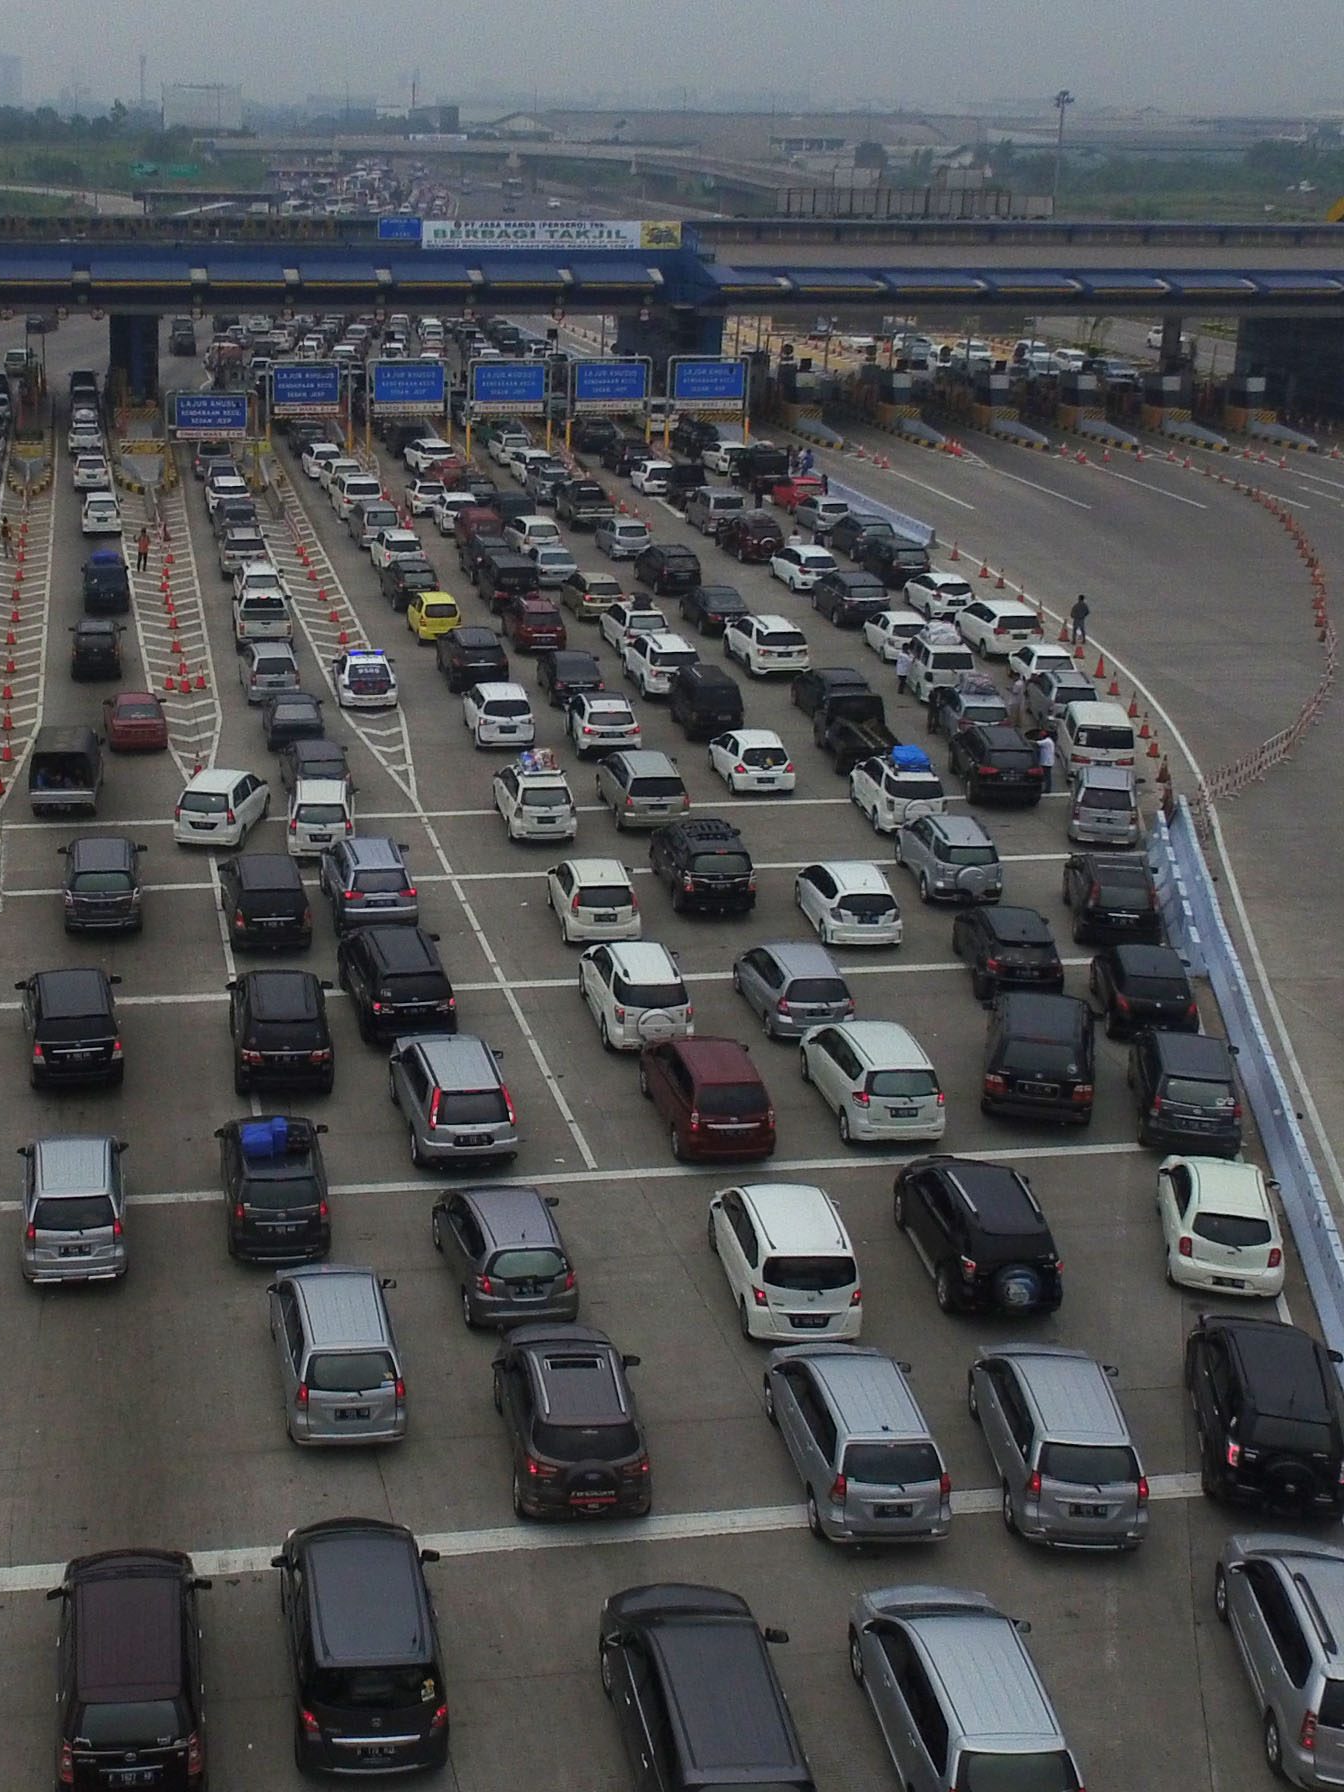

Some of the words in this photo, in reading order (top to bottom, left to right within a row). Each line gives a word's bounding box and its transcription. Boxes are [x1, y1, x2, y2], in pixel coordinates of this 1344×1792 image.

[433, 229, 536, 239] BERBAGI
[546, 229, 627, 239] TAKJIL
[180, 400, 208, 408] LAJUR
